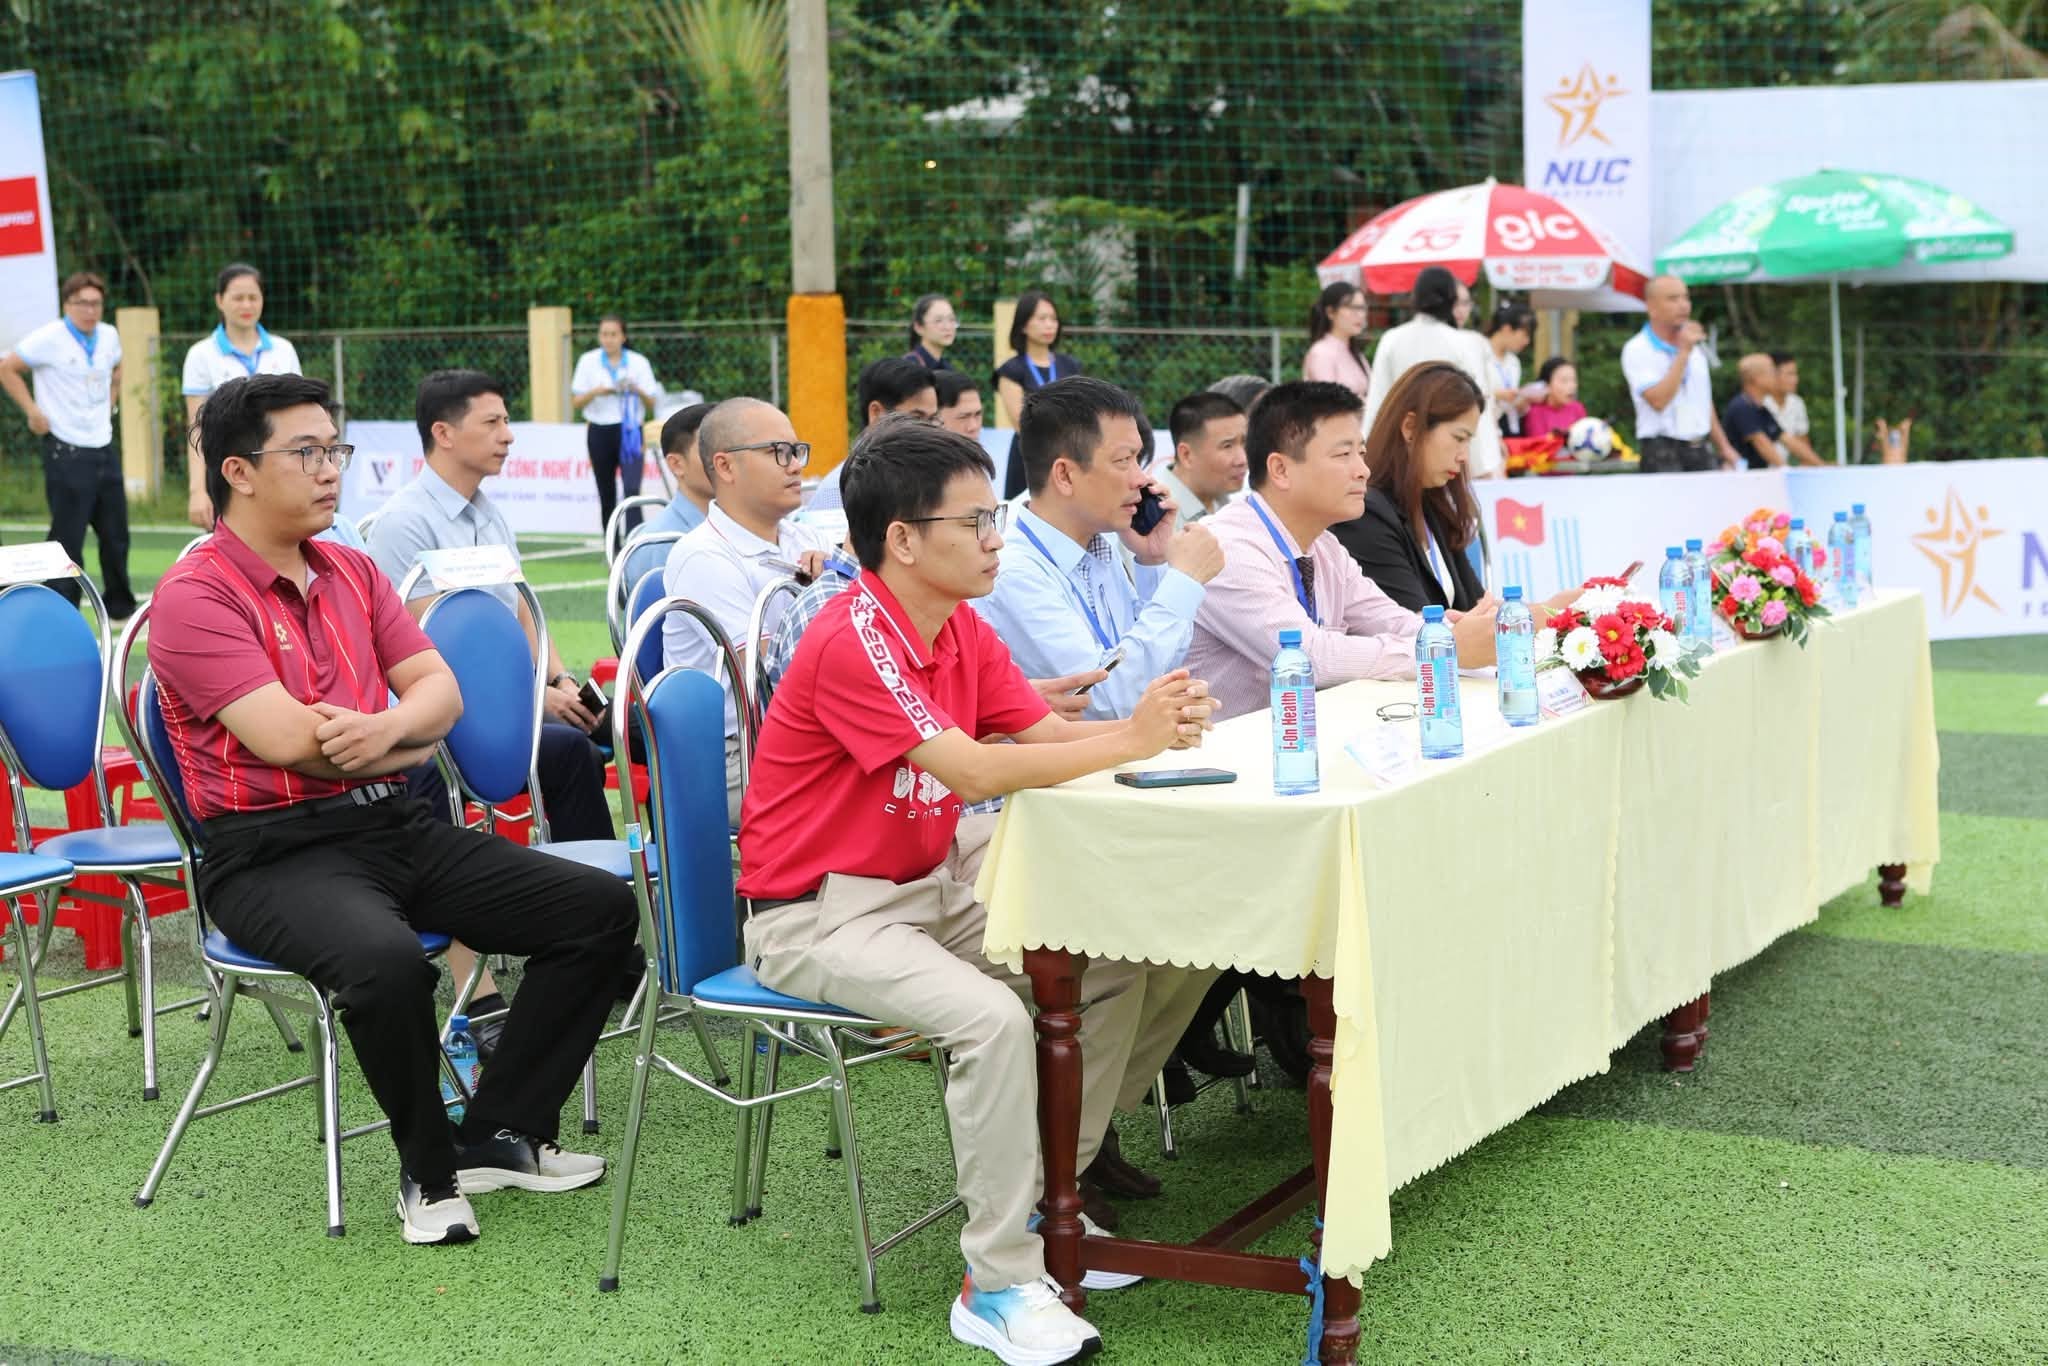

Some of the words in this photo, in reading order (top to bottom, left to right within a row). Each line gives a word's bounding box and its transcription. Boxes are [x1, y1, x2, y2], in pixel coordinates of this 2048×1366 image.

[1543, 157, 1631, 186] NUC
[1420, 663, 1434, 693] Health
[1280, 691, 1297, 725] Health
